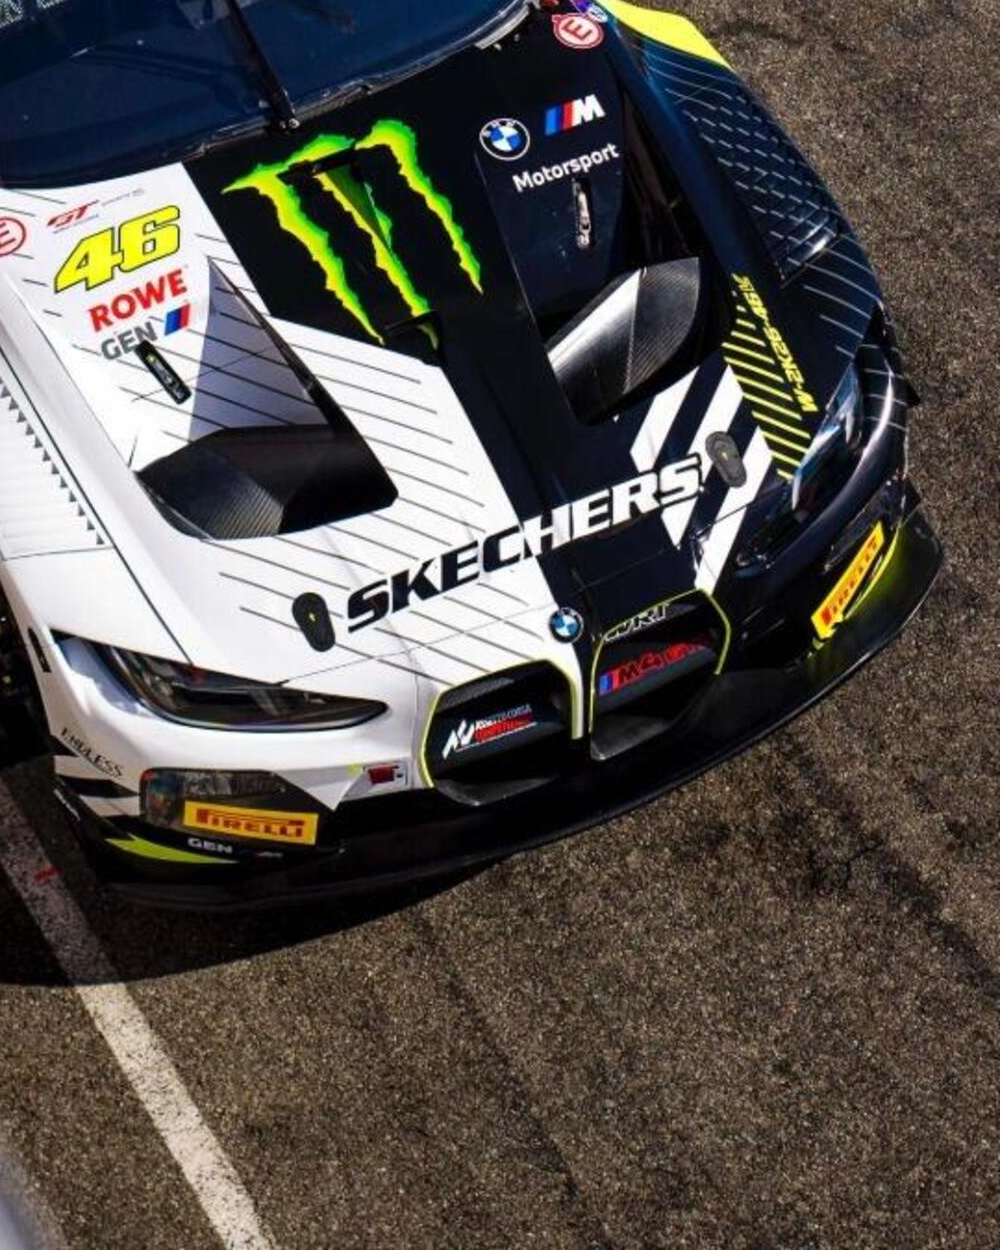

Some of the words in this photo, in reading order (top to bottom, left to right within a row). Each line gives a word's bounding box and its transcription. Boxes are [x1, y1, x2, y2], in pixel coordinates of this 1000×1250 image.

[512, 143, 619, 193] Motorsport
[53, 204, 181, 294] 46
[89, 268, 188, 333] ROWE
[100, 321, 158, 361] GEN
[347, 453, 704, 634] SKECHERS
[187, 837, 233, 854] GEN
[196, 808, 305, 838] PIRELLI
